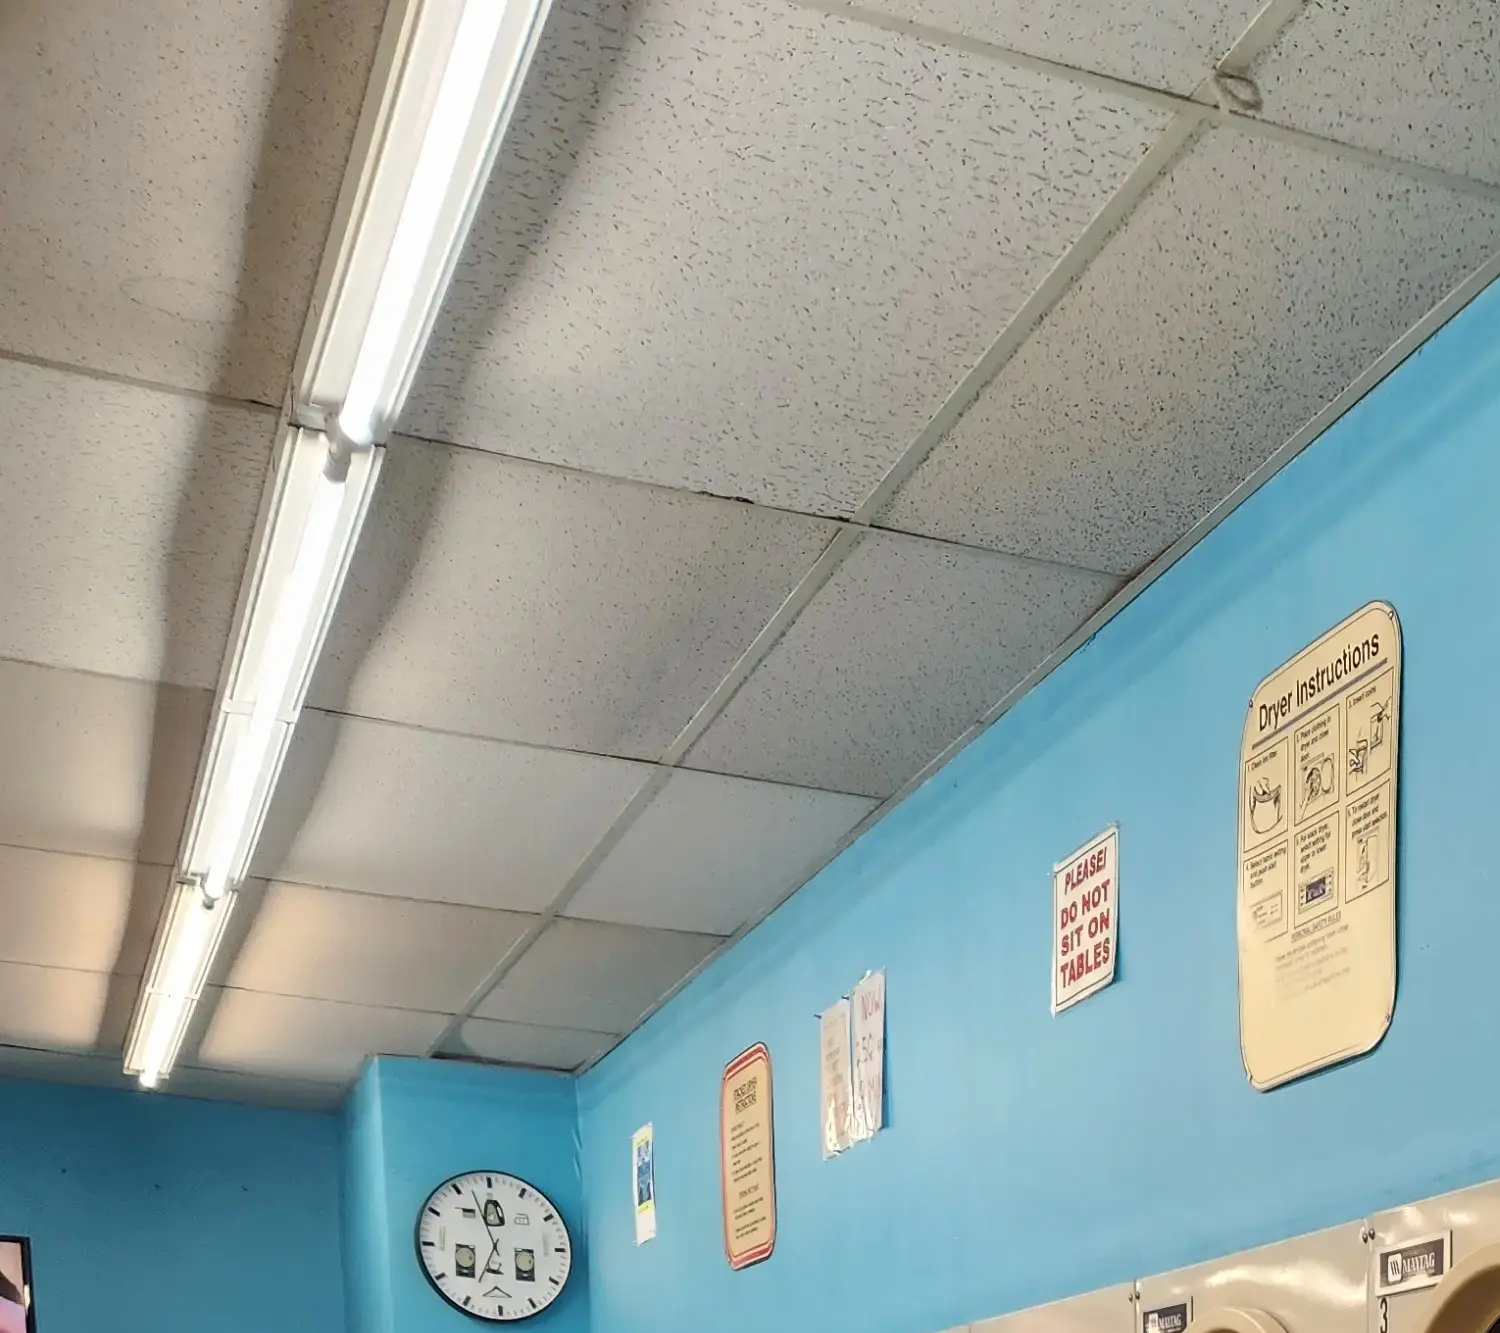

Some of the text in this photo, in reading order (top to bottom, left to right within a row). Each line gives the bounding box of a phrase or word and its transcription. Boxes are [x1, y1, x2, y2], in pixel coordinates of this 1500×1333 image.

[1259, 631, 1380, 732] Dryer Instructions
[1064, 846, 1108, 895] PLEASE!
[1060, 878, 1110, 930] DO NOT
[1061, 908, 1110, 956] SIT ON
[1060, 937, 1110, 988] TABLES
[1402, 1252, 1435, 1274] MAYTAG
